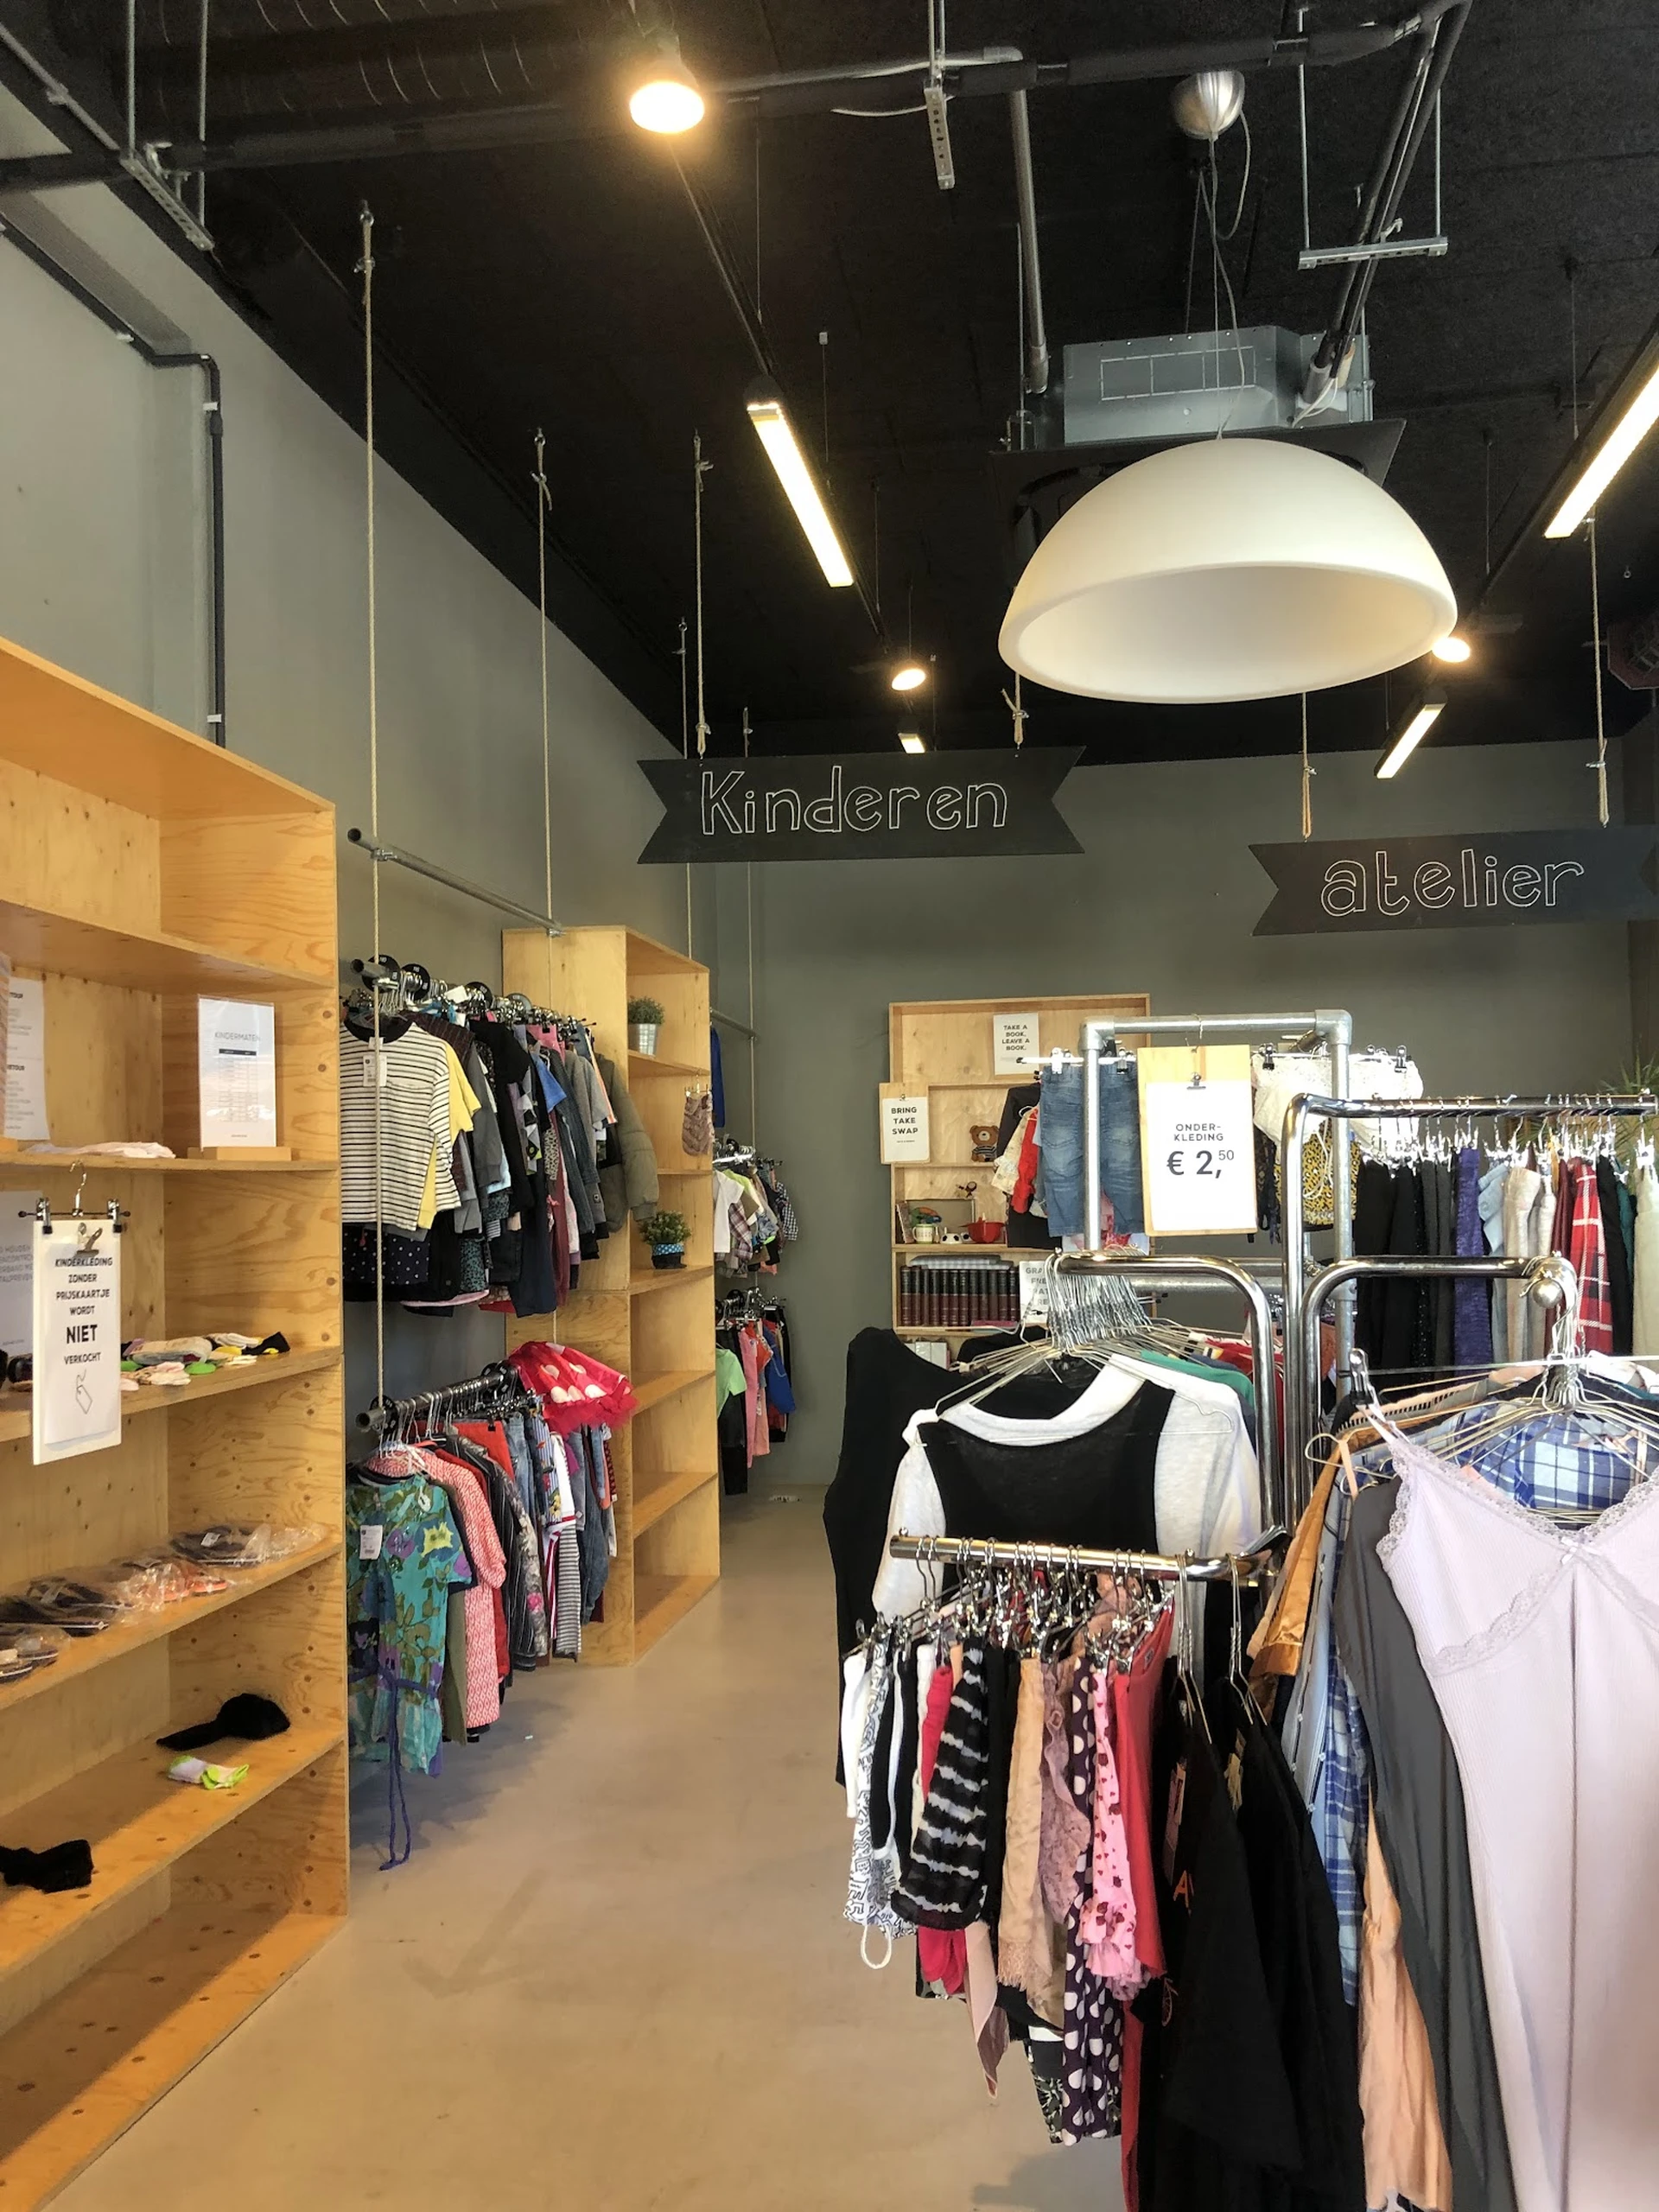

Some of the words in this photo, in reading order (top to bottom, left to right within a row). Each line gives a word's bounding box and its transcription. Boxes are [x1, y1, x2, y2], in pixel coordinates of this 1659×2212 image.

[701, 766, 1008, 835] Kinderen
[1320, 849, 1585, 917] atelier
[1166, 1151, 1185, 1175] €
[55, 1257, 113, 1268] KINDERKLEDING
[68, 1274, 97, 1283] ZONDER
[56, 1289, 110, 1300] PRIJSKAARTJE
[69, 1306, 95, 1315] WORDT
[67, 1325, 98, 1344] NIET
[64, 1352, 101, 1364] VERKOCHT
